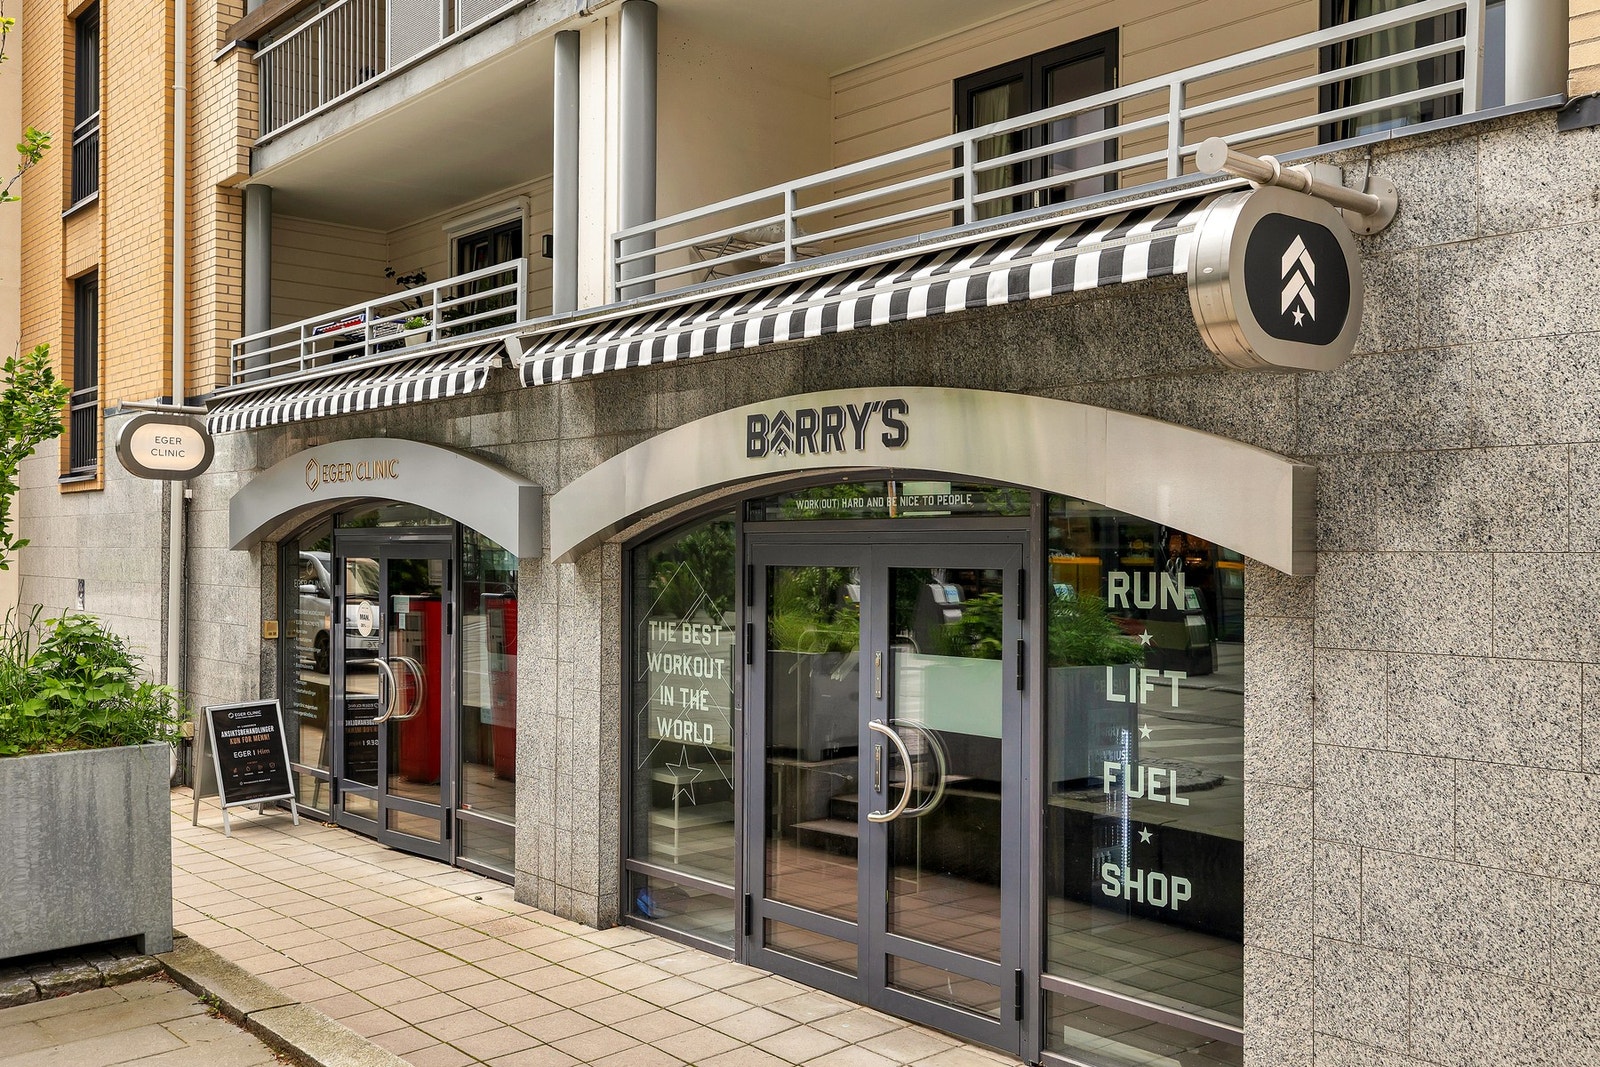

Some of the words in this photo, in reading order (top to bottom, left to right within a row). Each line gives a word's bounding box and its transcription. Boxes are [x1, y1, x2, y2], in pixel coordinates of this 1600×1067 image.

[154, 435, 182, 445] EGER
[746, 398, 909, 458] BARRY'S
[150, 448, 186, 458] CLINIC
[322, 462, 353, 484] EGER
[356, 459, 400, 481] CLINIC
[841, 497, 864, 508] HARD
[866, 496, 884, 508] AND
[886, 496, 898, 507] BE
[899, 496, 920, 507] NICE
[922, 495, 935, 506] TO
[1107, 571, 1186, 611] RUN
[648, 621, 677, 642] THE
[682, 622, 723, 646] BEST
[646, 652, 725, 680] WORKOUT
[660, 685, 674, 707] IN
[680, 687, 710, 711] THE
[1106, 665, 1187, 707] LIFT
[241, 735, 252, 743] FOR
[656, 716, 714, 745] WORLD
[233, 750, 252, 759] EGER
[1103, 761, 1190, 806] FUEL
[1101, 862, 1192, 911] SHOP
